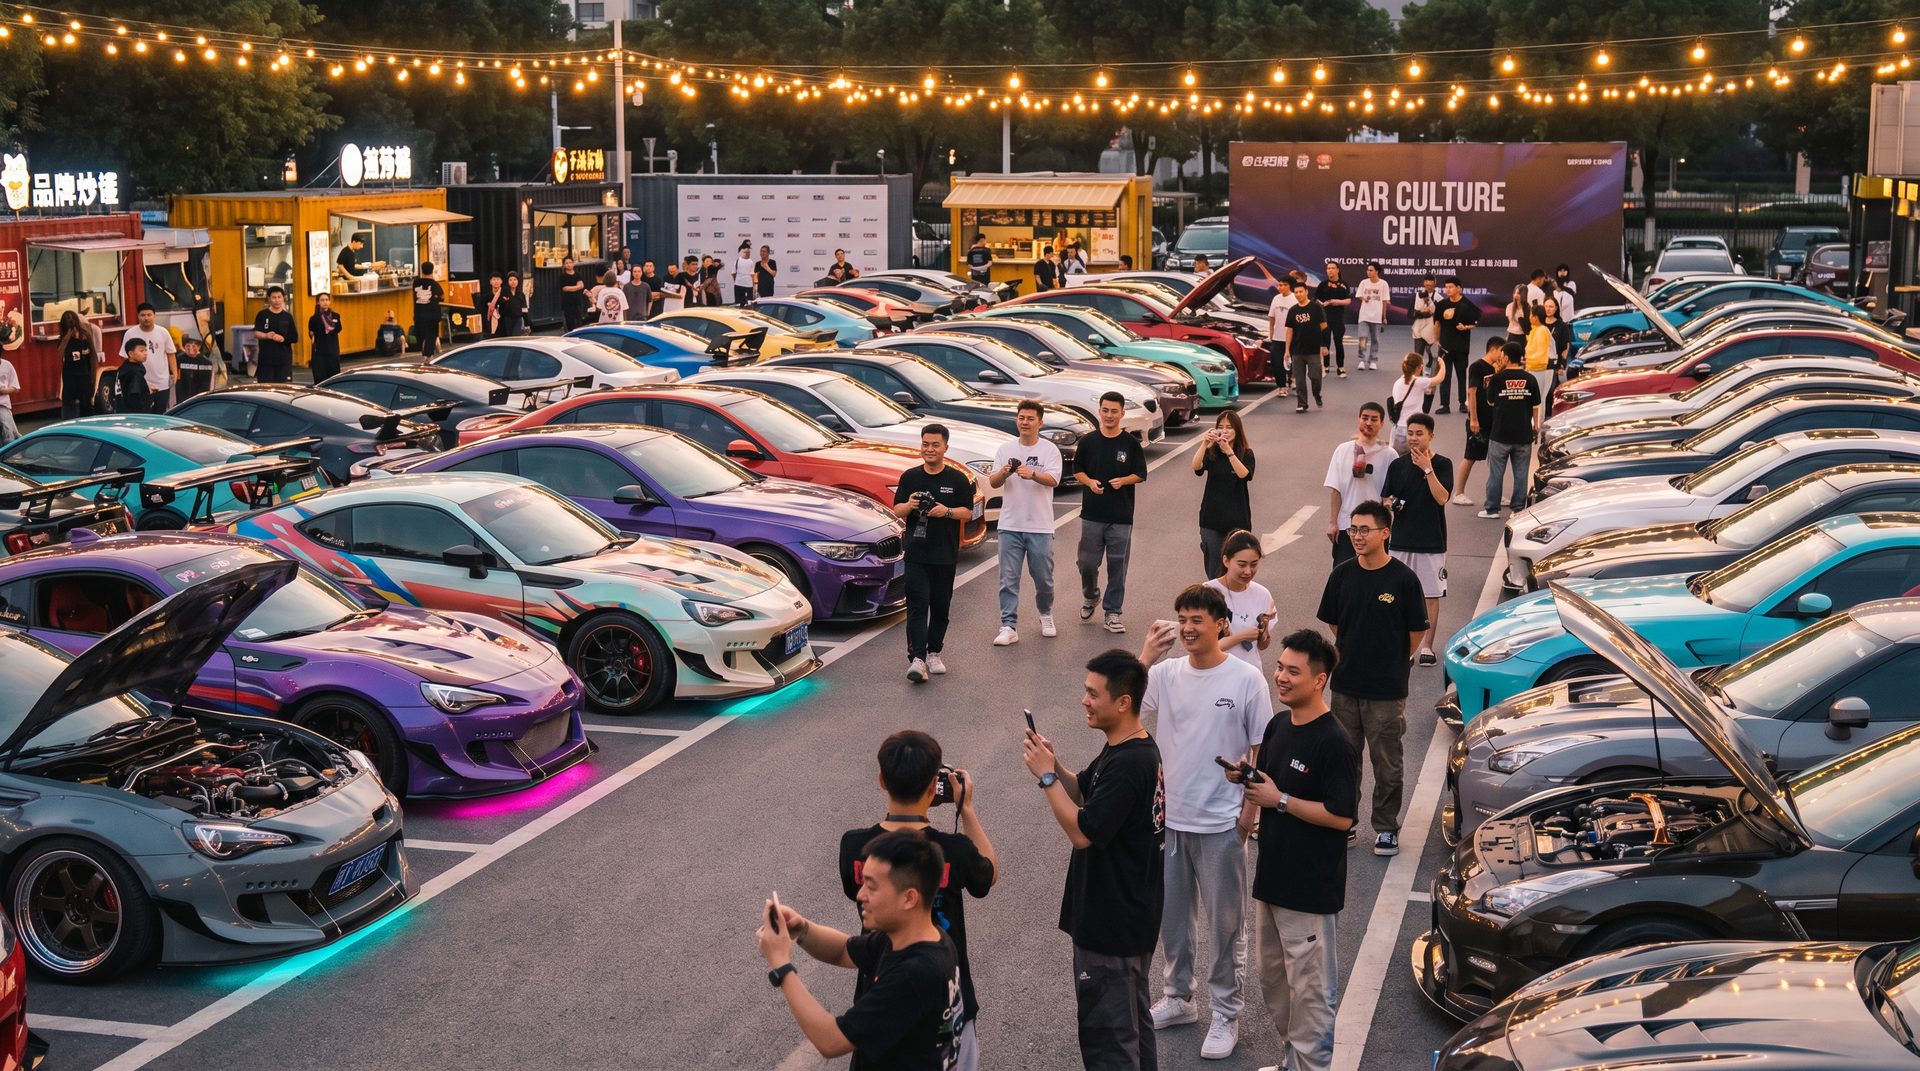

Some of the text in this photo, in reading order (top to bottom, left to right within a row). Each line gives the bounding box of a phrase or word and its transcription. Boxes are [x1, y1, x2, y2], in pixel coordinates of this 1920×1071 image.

[1339, 181, 1506, 212] CAR CULTURE
[1382, 215, 1460, 246] CHINA
